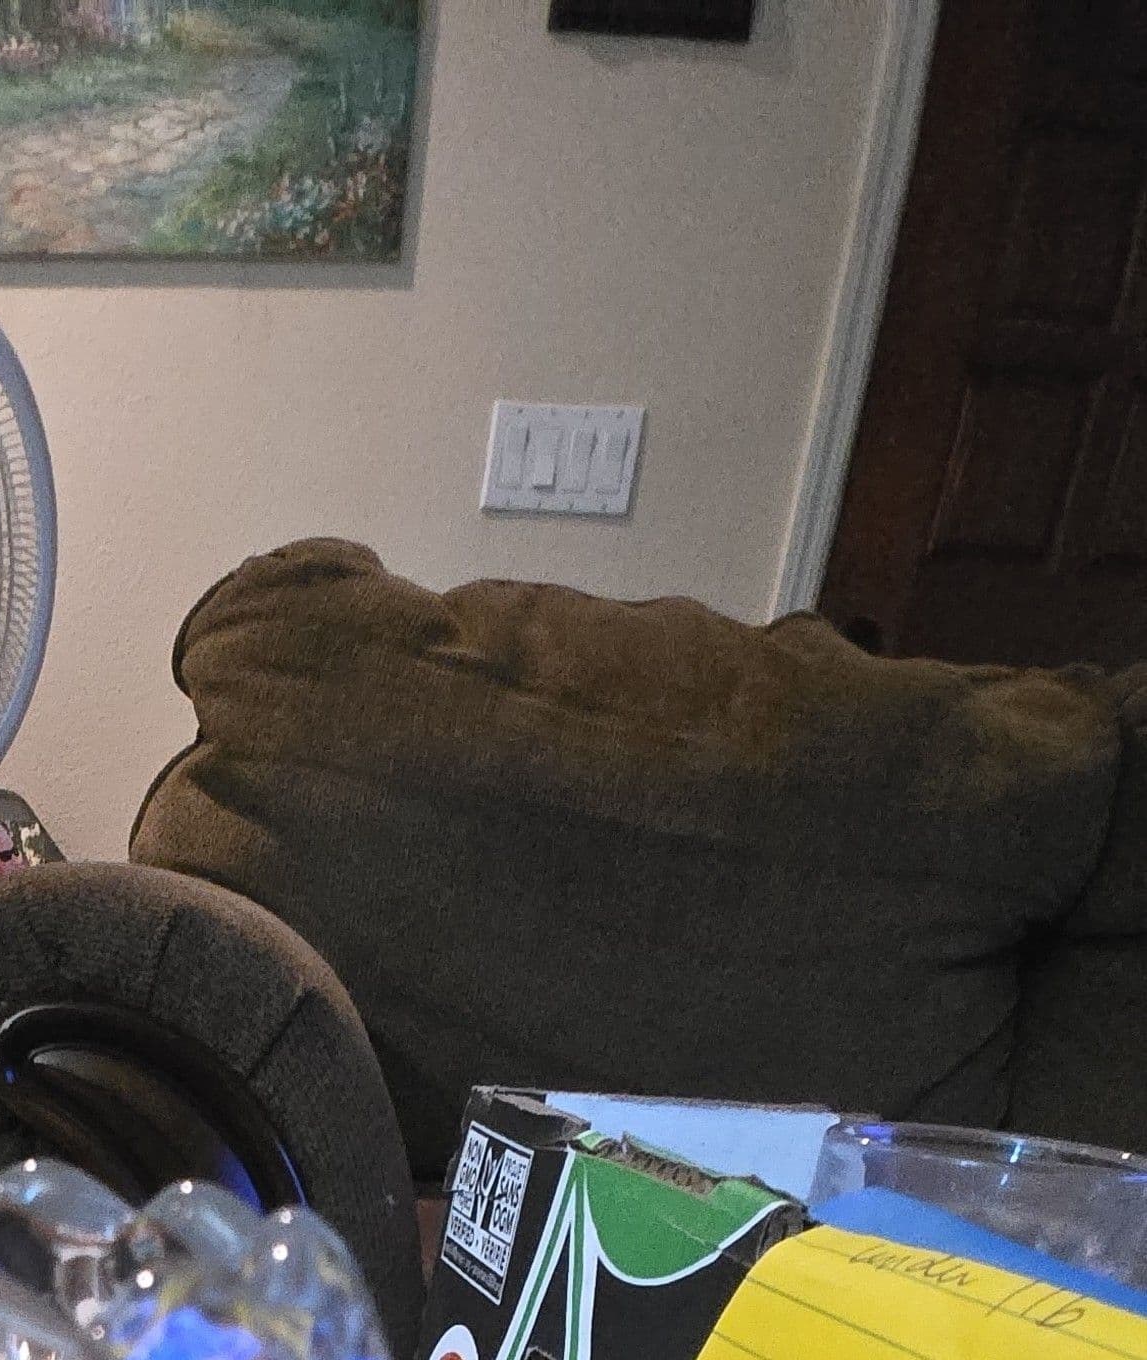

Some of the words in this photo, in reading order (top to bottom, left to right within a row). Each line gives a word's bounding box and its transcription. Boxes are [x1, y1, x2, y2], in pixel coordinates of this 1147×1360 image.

[459, 1162, 478, 1192] GMO
[500, 1174, 522, 1209] SANS
[492, 1202, 516, 1236] OGM
